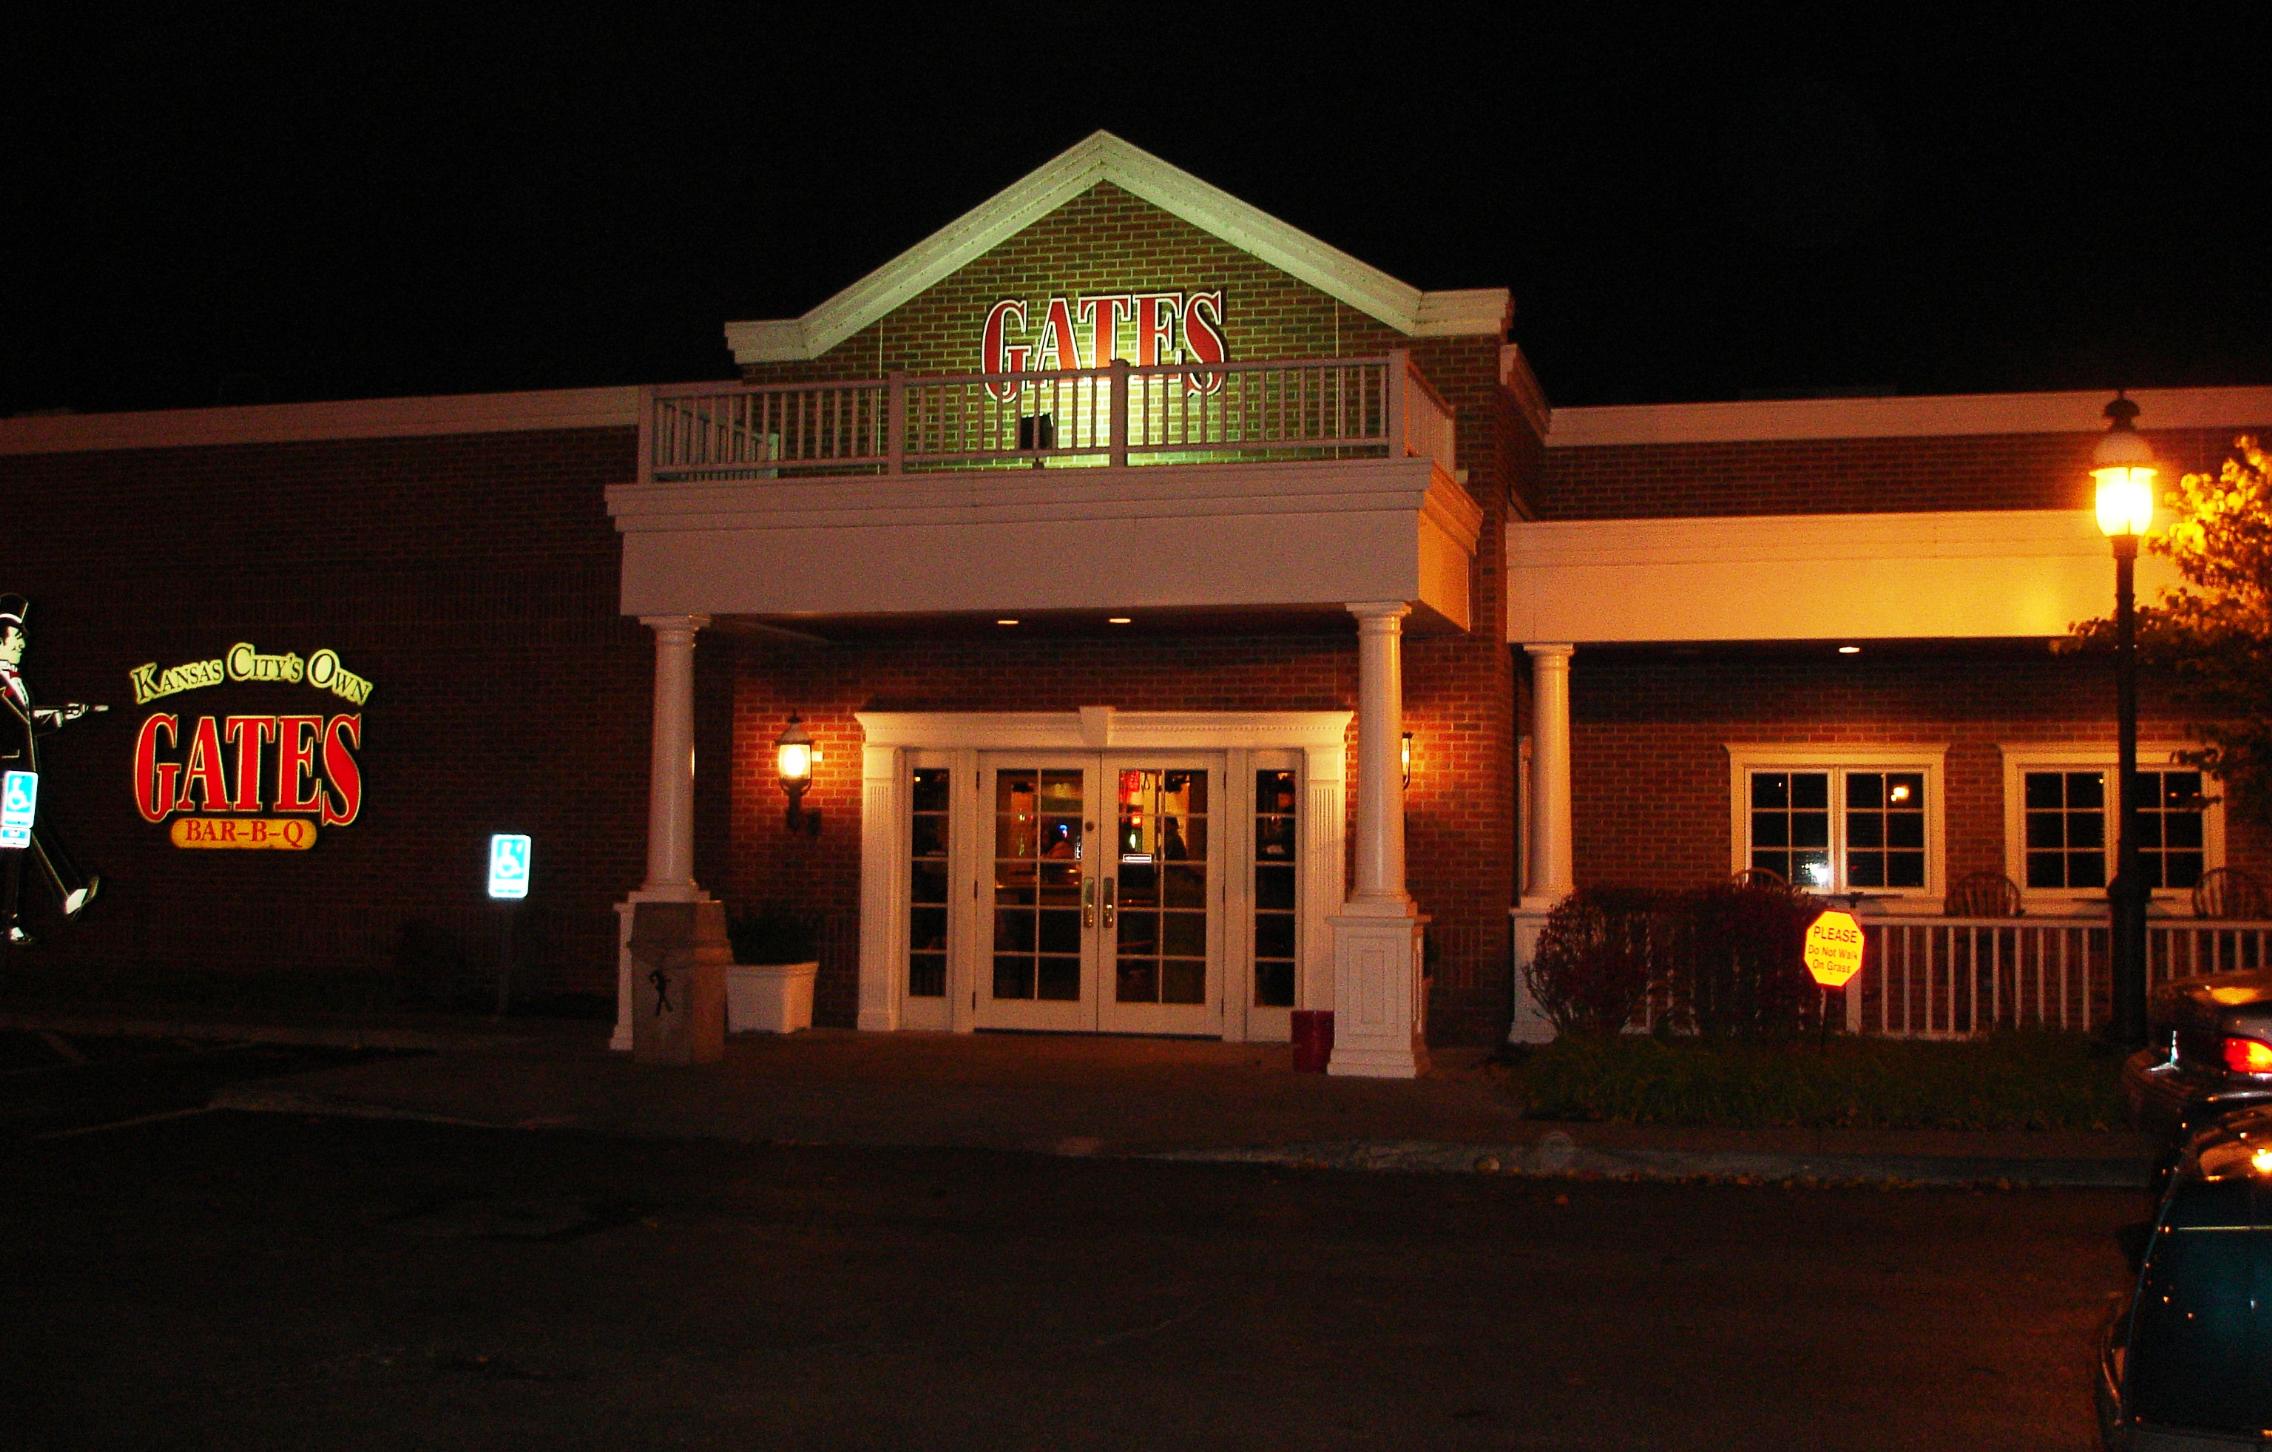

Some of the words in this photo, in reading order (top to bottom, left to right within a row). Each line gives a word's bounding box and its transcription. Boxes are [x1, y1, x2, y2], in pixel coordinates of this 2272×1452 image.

[981, 290, 1226, 403] GATES
[132, 663, 223, 700] KANSAS
[230, 646, 303, 681] CITY'S
[311, 653, 371, 703] OWN
[134, 712, 362, 826] GATES
[184, 819, 304, 848] BAR-B-Q
[1813, 925, 1857, 944] PLEASE
[1808, 944, 1819, 955] Do
[1822, 946, 1837, 958] Not
[1839, 948, 1858, 961] Walk
[1812, 958, 1825, 970] On
[1827, 960, 1851, 974] Grass
